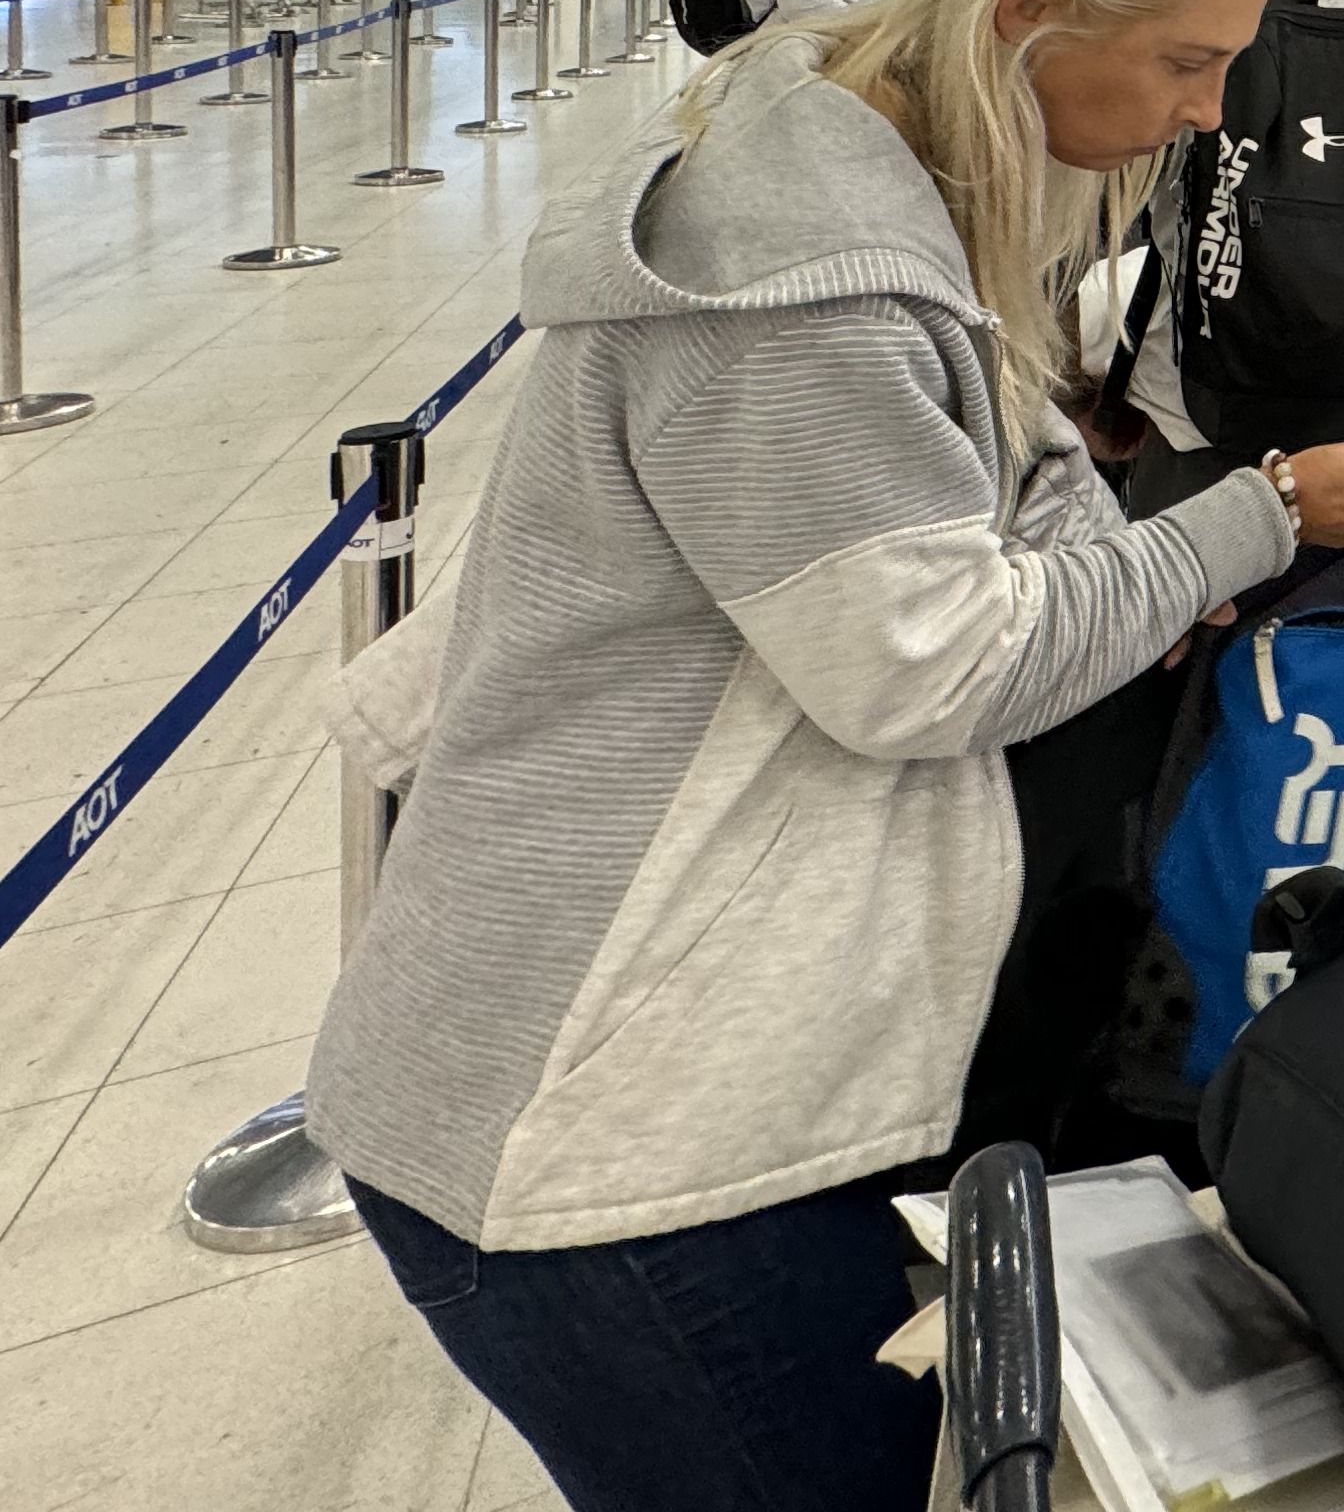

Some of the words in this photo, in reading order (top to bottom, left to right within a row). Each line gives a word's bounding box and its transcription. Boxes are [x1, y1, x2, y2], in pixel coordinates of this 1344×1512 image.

[1210, 137, 1260, 300] UNDER
[256, 576, 295, 643] AOT
[67, 764, 126, 858] AOT
